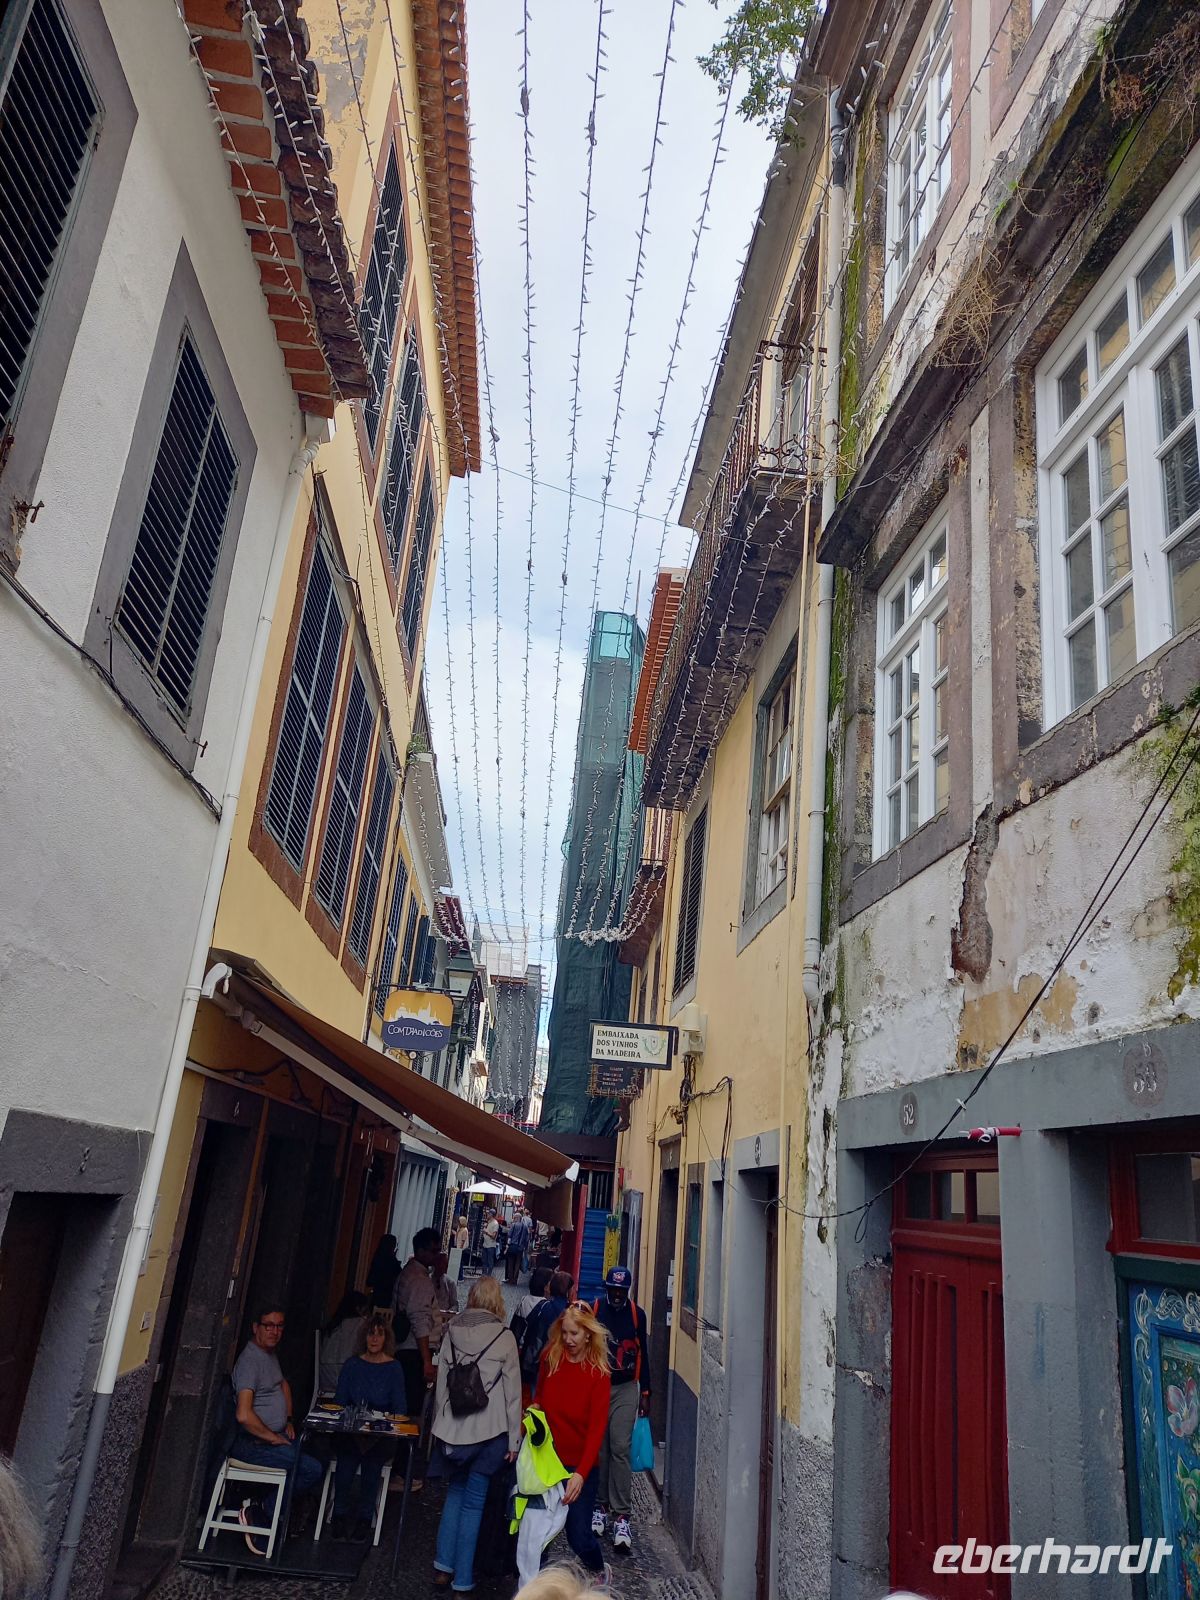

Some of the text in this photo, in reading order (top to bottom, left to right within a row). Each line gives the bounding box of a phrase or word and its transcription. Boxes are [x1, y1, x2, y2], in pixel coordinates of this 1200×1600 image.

[597, 1030, 639, 1039] EMBAIXADA
[612, 1040, 638, 1048] VINHOS
[607, 1049, 641, 1058] MADEIRA
[903, 1103, 915, 1126] 52
